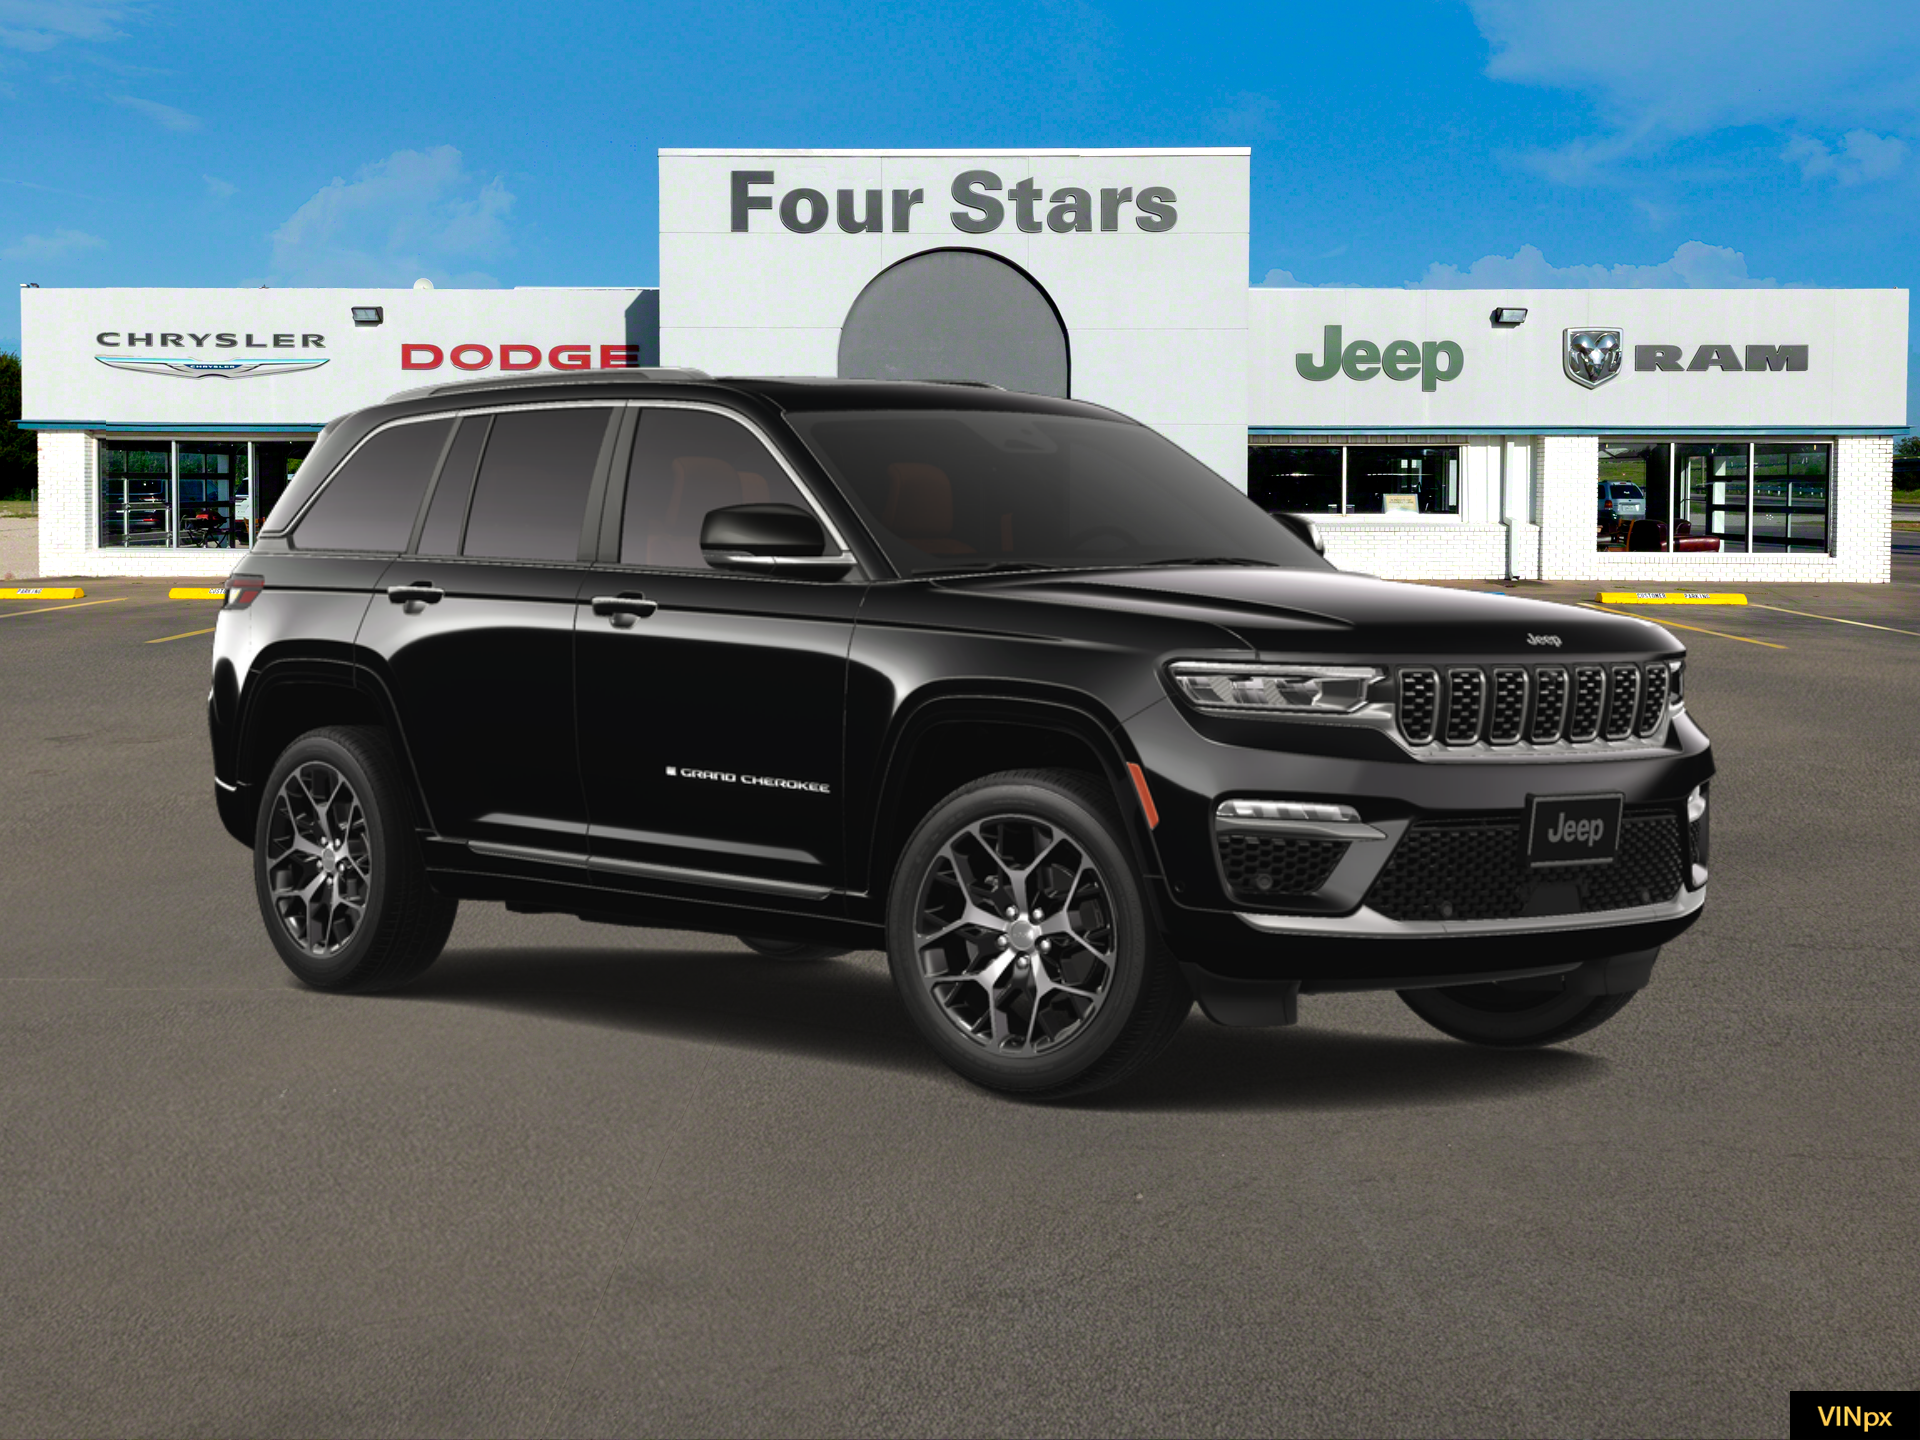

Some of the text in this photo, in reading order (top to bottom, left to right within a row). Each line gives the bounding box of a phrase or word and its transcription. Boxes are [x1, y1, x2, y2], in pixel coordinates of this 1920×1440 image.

[730, 169, 1178, 234] Four Stars
[96, 332, 326, 348] CHRYSLER
[401, 343, 640, 371] DODGE
[1295, 325, 1464, 393] Jeep
[1634, 344, 1809, 371] RAM
[1526, 632, 1563, 647] Jeep
[680, 768, 831, 794] GRAND CHEROKEE
[1547, 811, 1605, 847] Jeep
